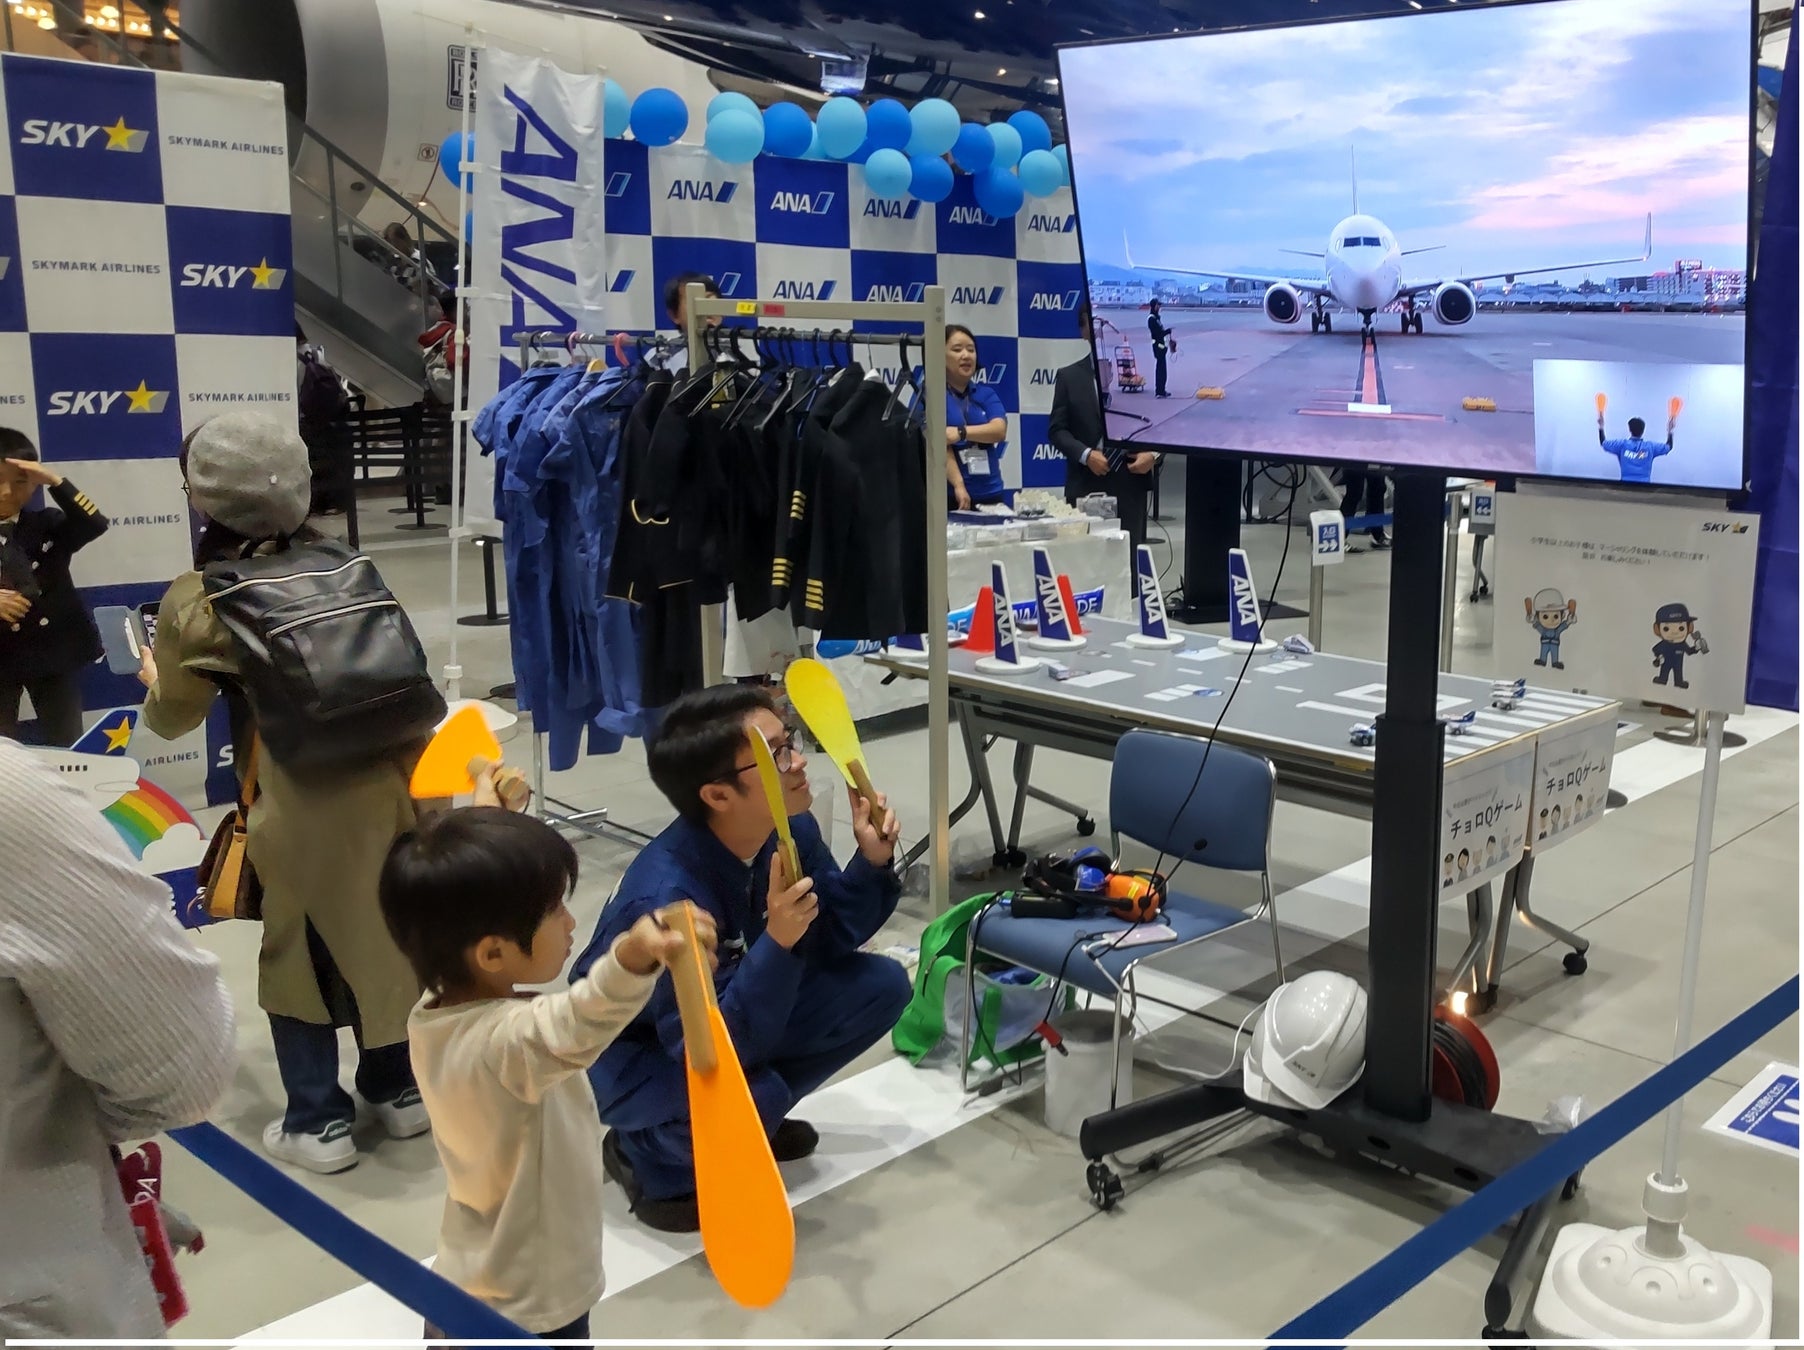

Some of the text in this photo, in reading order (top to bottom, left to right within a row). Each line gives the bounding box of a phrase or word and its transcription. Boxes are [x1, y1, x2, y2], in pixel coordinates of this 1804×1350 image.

[21, 119, 101, 148] SKY
[168, 135, 285, 156] SKYMARK AIRLINES
[667, 180, 714, 201] ANA
[770, 191, 811, 213] ANA
[863, 198, 905, 218] ANA
[501, 83, 577, 350] ANA
[949, 206, 983, 225] ANA
[1028, 214, 1061, 233] ANA
[32, 259, 161, 274] SKYMARK AIRLINES
[180, 263, 249, 288] SKY
[773, 280, 816, 300] ANA
[866, 284, 902, 302] ANA
[951, 286, 986, 304] ANA
[1029, 292, 1062, 311] ANA
[47, 391, 123, 415] SKY
[188, 392, 291, 402] SKYMARK AIRLINES
[123, 513, 181, 526] AIRLINES
[1701, 521, 1731, 534] SKY
[1036, 573, 1065, 626] ANA
[1139, 573, 1163, 625] ANA
[1231, 574, 1258, 626] ANA
[993, 591, 1013, 647] ANA
[145, 750, 199, 768] AIRLINES
[1546, 754, 1606, 796] チョロQゲーム
[1450, 793, 1523, 841] チョロQゲーム
